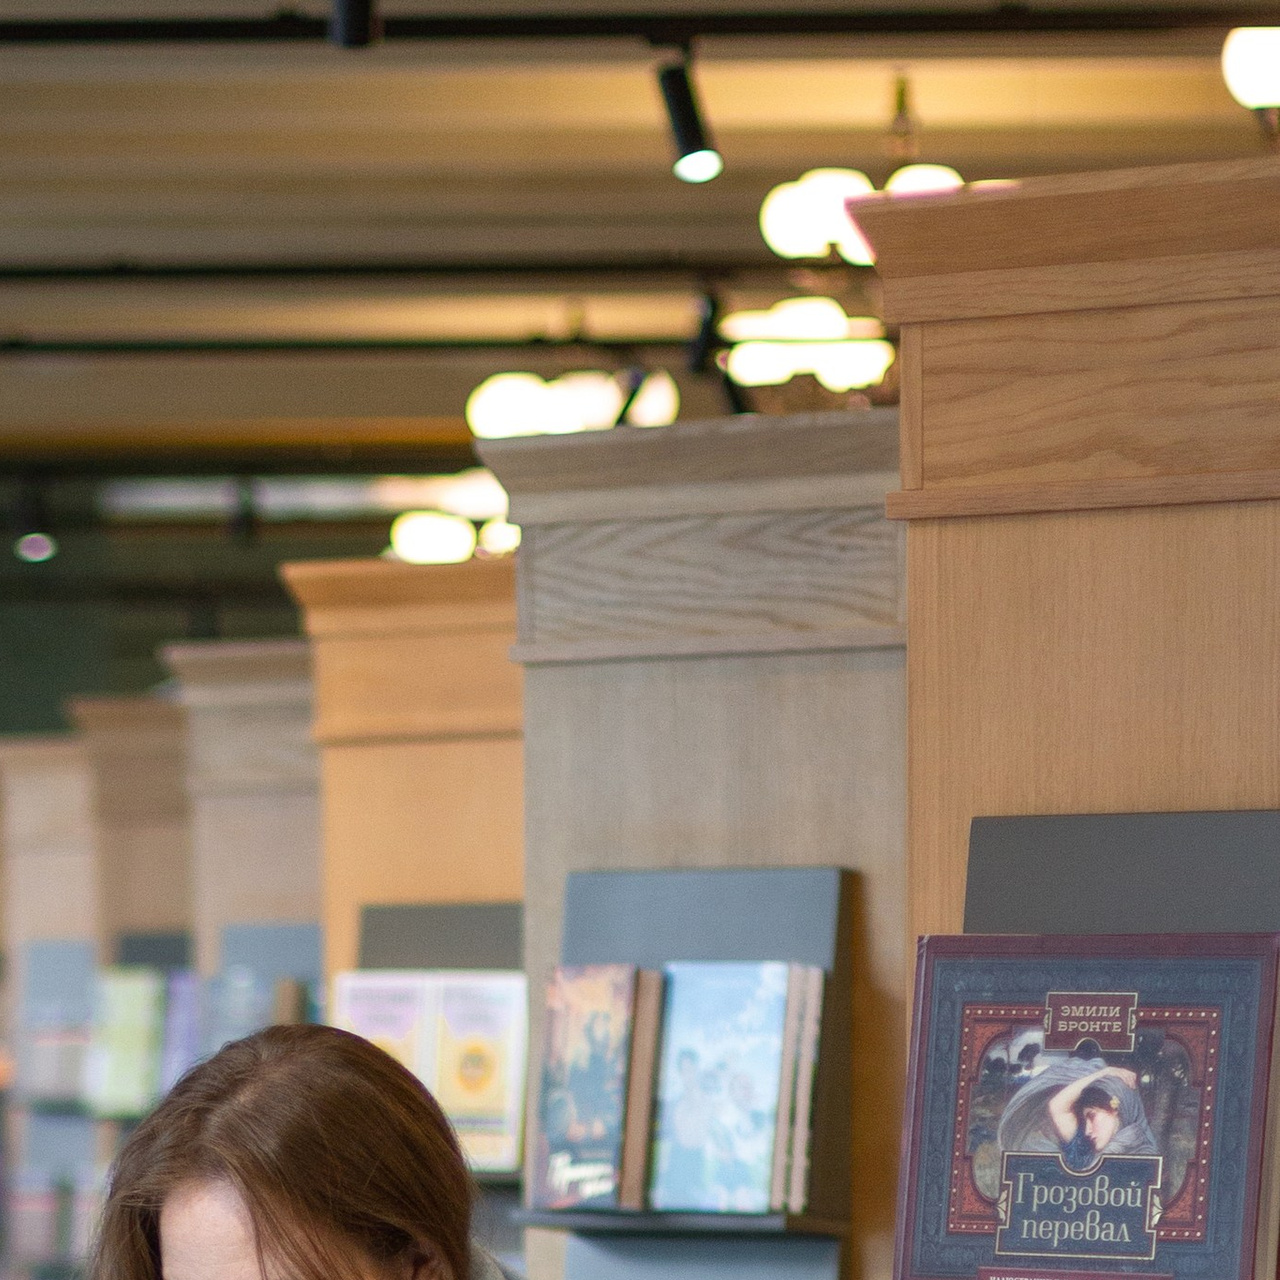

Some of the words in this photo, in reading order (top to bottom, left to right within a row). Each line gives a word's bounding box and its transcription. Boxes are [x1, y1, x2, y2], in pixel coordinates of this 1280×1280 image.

[1060, 1005, 1121, 1017] ЭМИЛИ
[1057, 1020, 1122, 1033] БРОНТЕ
[1015, 1172, 1143, 1214] Грозовой
[1021, 1209, 1132, 1248] перевал
